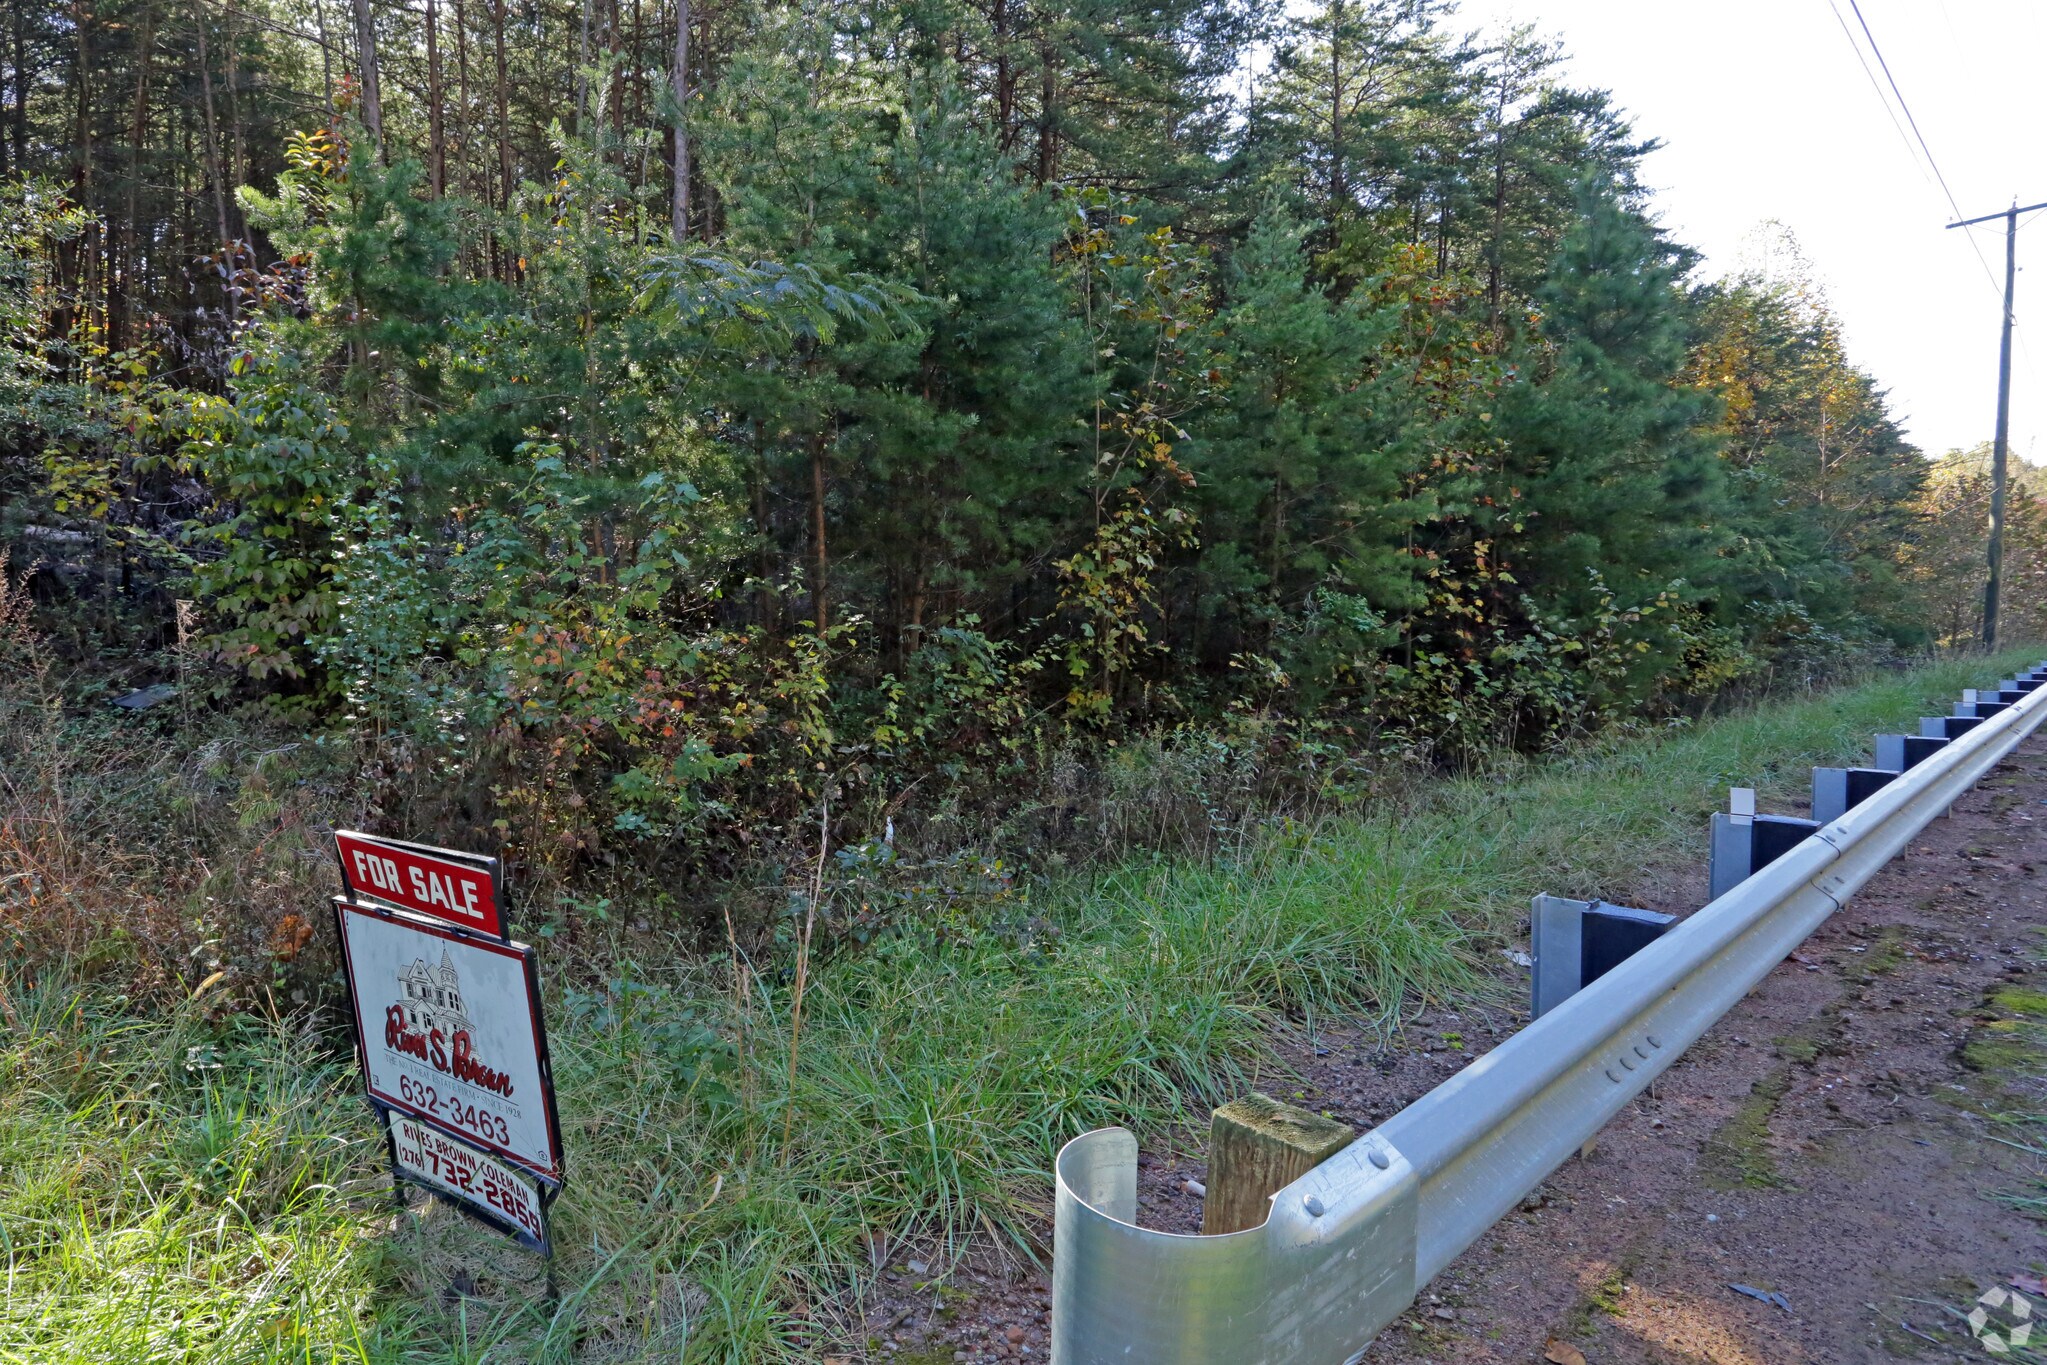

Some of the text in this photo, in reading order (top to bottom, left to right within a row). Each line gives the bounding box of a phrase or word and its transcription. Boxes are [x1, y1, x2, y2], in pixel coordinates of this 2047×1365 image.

[352, 849, 484, 920] FOR SALE
[385, 1053, 398, 1066] THE
[414, 1065, 430, 1080] REAL
[432, 1074, 455, 1092] ESTATE
[457, 1083, 476, 1100] FIRM
[481, 1096, 504, 1113] SINCE
[506, 1105, 522, 1119] 1928
[430, 1028, 451, 1074] S.
[453, 1030, 514, 1098] Brown
[400, 1074, 510, 1147] 632-3463
[403, 1122, 530, 1206] RIVES BROWN COLEMAN
[425, 1150, 544, 1244] 732-2859
